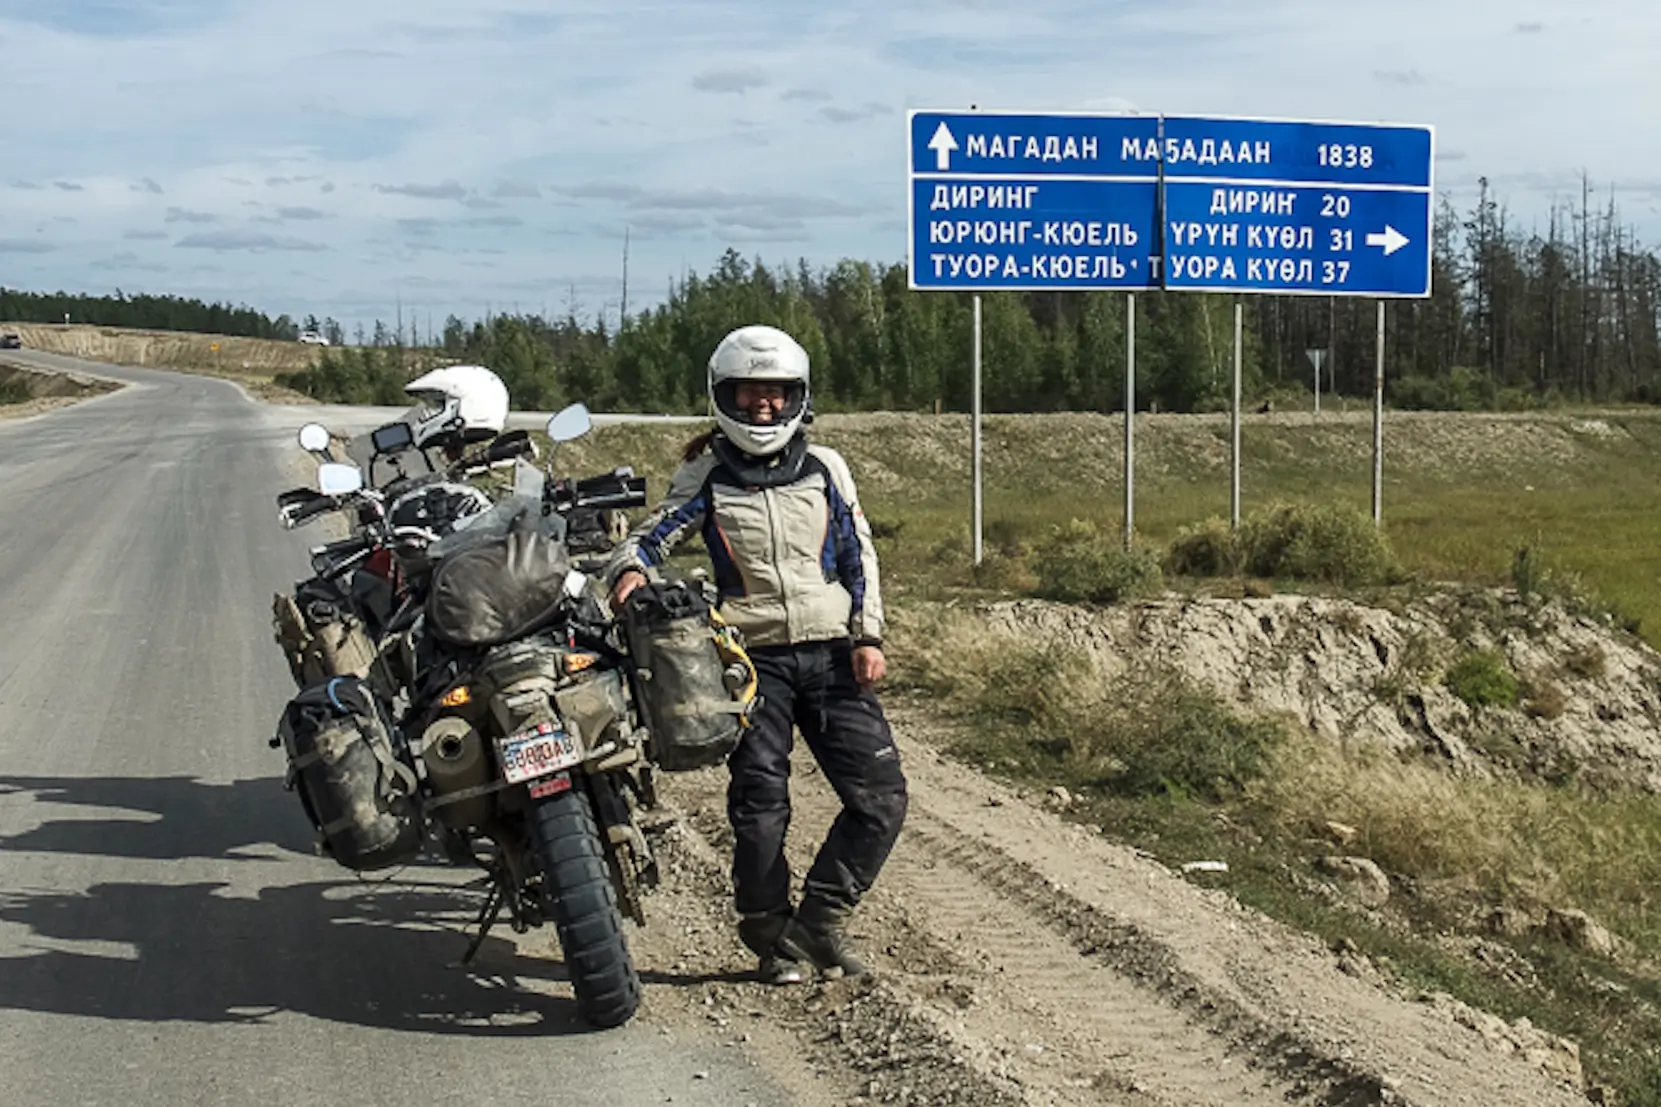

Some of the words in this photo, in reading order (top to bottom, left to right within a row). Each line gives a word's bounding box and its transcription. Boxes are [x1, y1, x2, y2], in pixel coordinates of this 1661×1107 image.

[965, 134, 1098, 162] МАГАДАН
[1317, 143, 1374, 168] 1838
[929, 184, 1039, 211] ДИРИНГ
[1319, 194, 1351, 218] 20
[929, 220, 1138, 246] ЮРЮНГ-КЮЕЛЬ
[1329, 229, 1353, 251] 31
[930, 253, 1126, 279] ТУОРА-КЮЕЛЬ
[1321, 260, 1350, 284] 37
